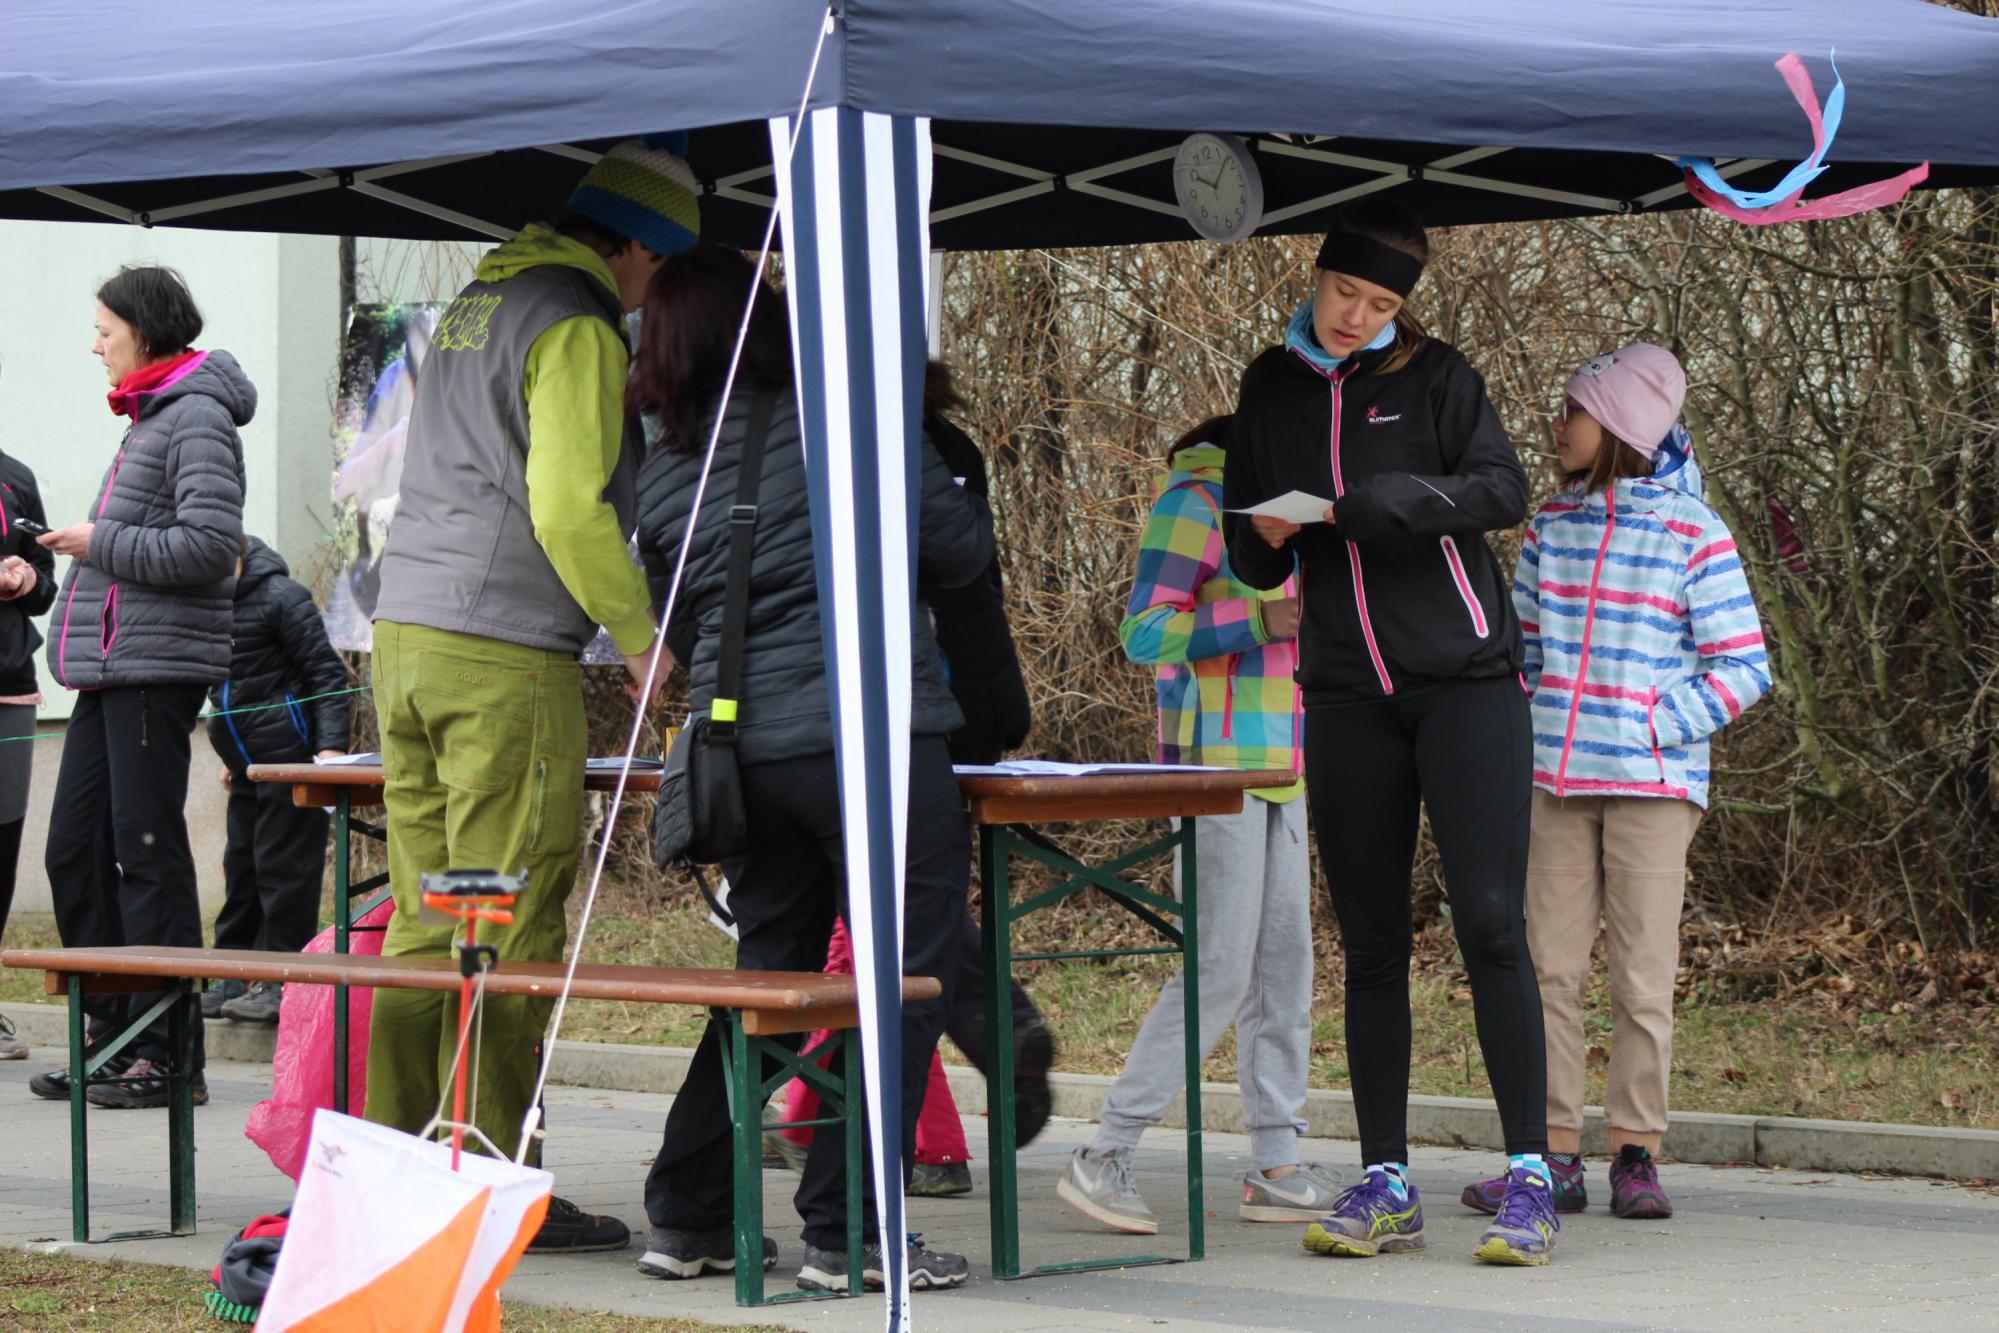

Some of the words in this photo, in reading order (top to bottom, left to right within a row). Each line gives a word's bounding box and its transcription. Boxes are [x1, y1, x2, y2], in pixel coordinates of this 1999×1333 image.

[1200, 146, 1212, 160] 12
[1215, 147, 1221, 161] 1
[1193, 153, 1200, 167] 11
[1236, 174, 1245, 188] 3
[1190, 189, 1198, 201] 9
[1200, 206, 1208, 218] 8
[1235, 208, 1242, 221] 5
[1213, 215, 1219, 228] 7
[1224, 216, 1232, 228] 6
